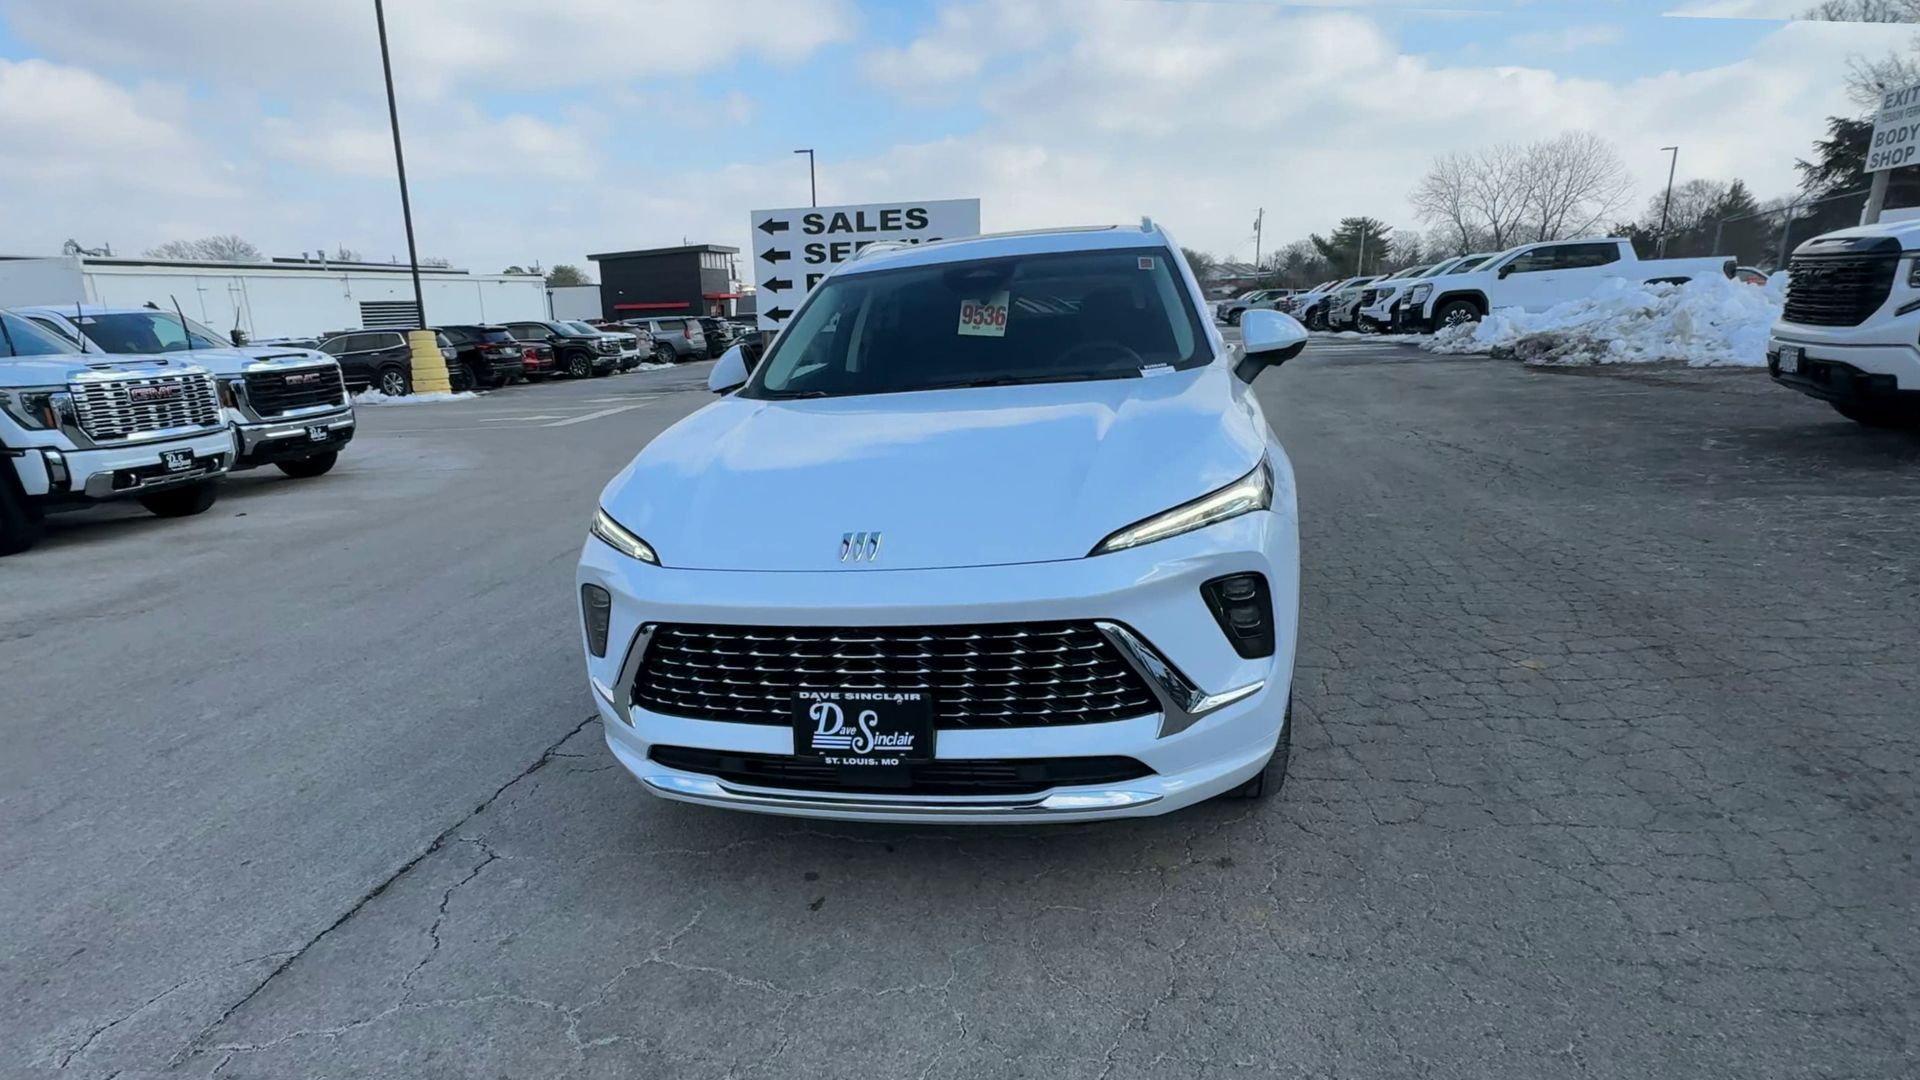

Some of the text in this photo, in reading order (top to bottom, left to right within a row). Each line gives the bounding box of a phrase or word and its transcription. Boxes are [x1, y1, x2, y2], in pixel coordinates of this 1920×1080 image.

[1883, 86, 1920, 109] EXIT
[1874, 123, 1920, 148] BODY
[1869, 146, 1915, 169] SHOP
[803, 208, 929, 235] SALES
[962, 304, 1006, 326] 9536
[131, 386, 181, 400] GMC
[799, 692, 921, 701] DAVE SINCLAIR
[809, 702, 914, 754] Dave Sinclair
[825, 757, 840, 765] ST.
[881, 758, 899, 766] MO
